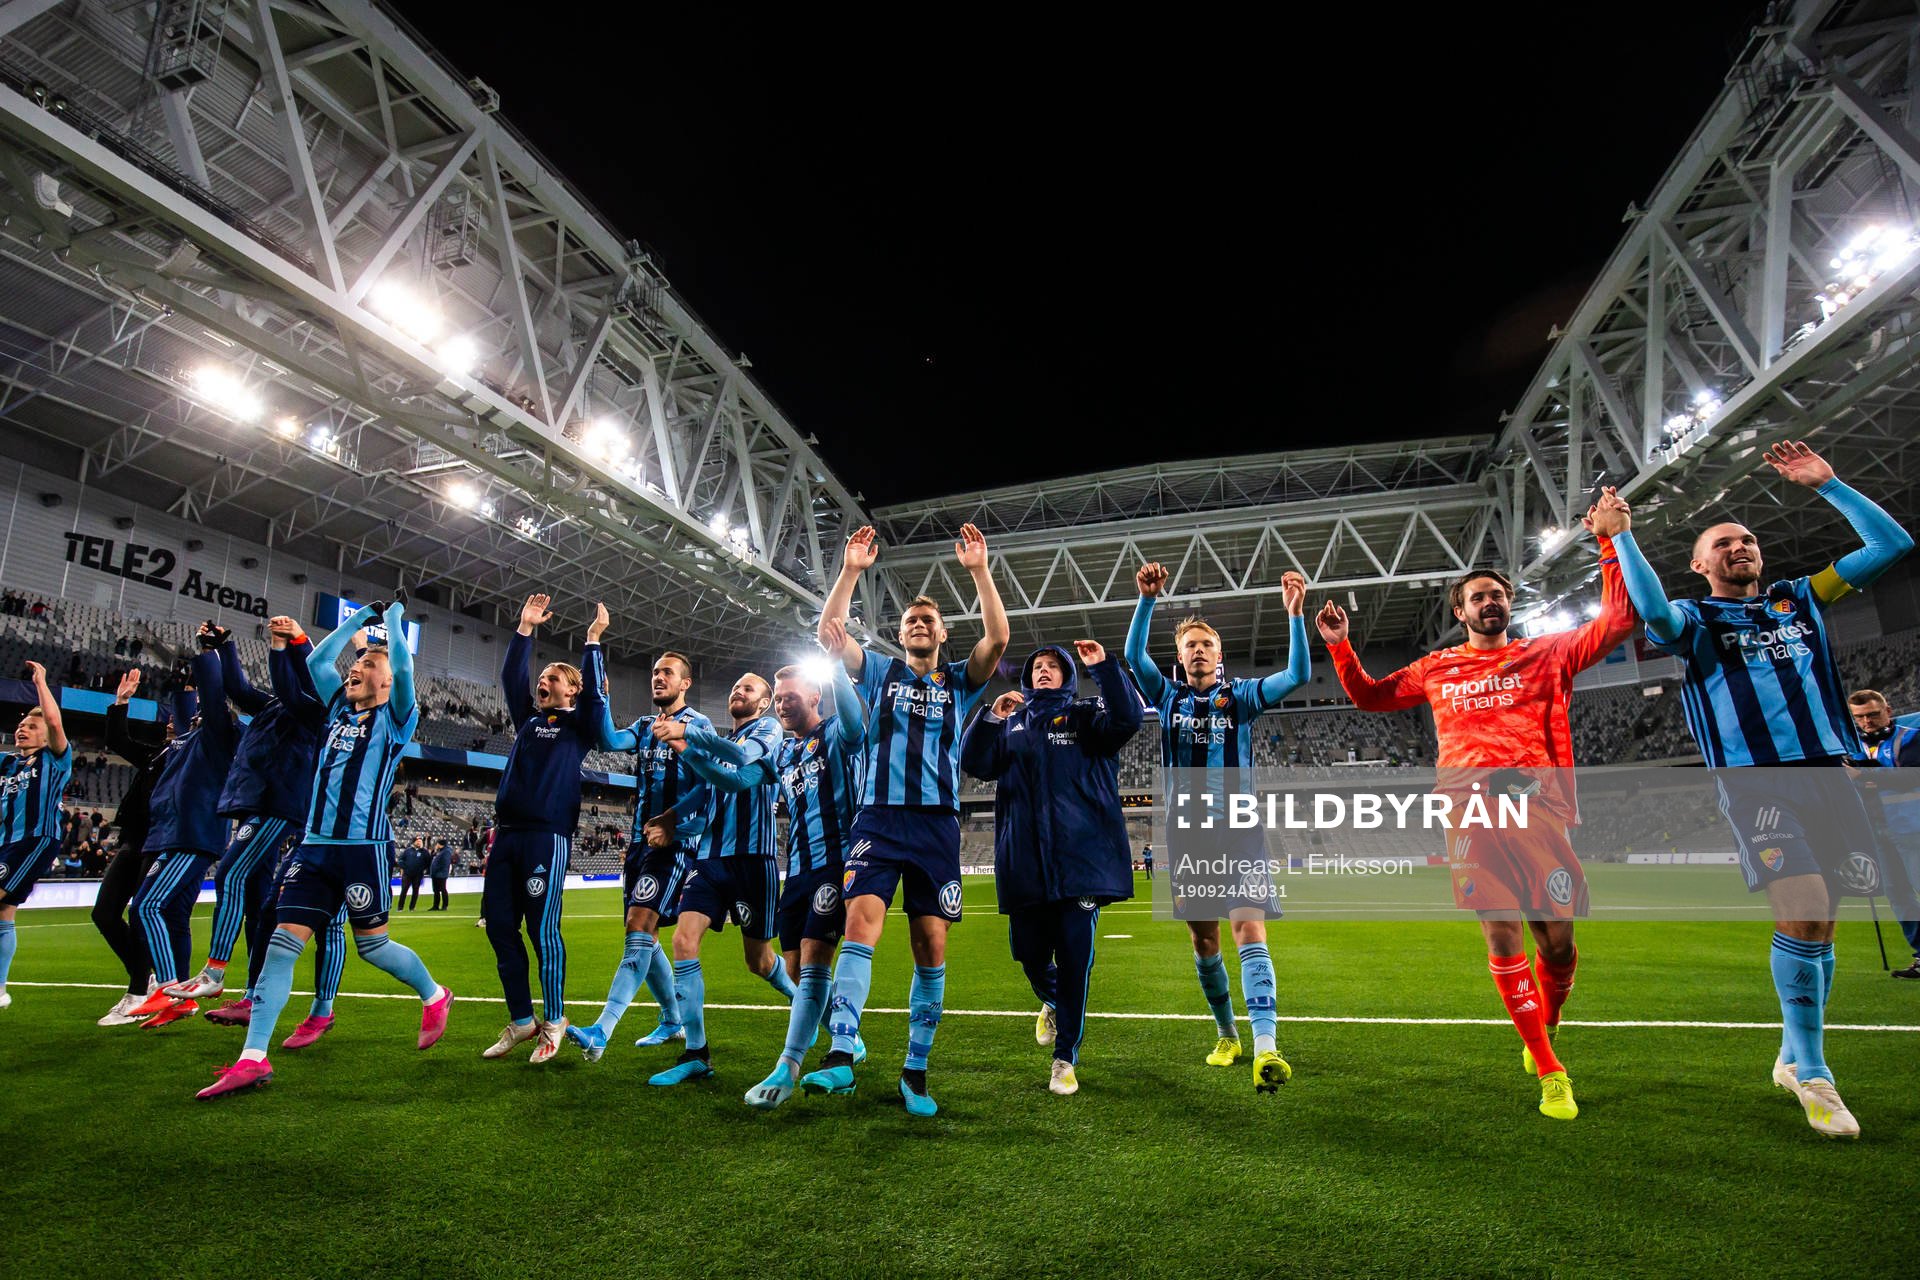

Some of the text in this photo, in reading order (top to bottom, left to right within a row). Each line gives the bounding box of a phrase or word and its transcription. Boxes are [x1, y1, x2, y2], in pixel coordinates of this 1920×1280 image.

[64, 532, 269, 619] TELE2 Arena
[1741, 642, 1811, 664] Finans
[887, 682, 952, 704] Prioritet
[1441, 672, 1523, 698] Prioritet
[892, 696, 943, 718] Finans
[1452, 693, 1514, 713] Finans
[1172, 712, 1234, 729] Prioritet
[1179, 729, 1225, 744] Finans
[1751, 832, 1794, 843] NRC Group
